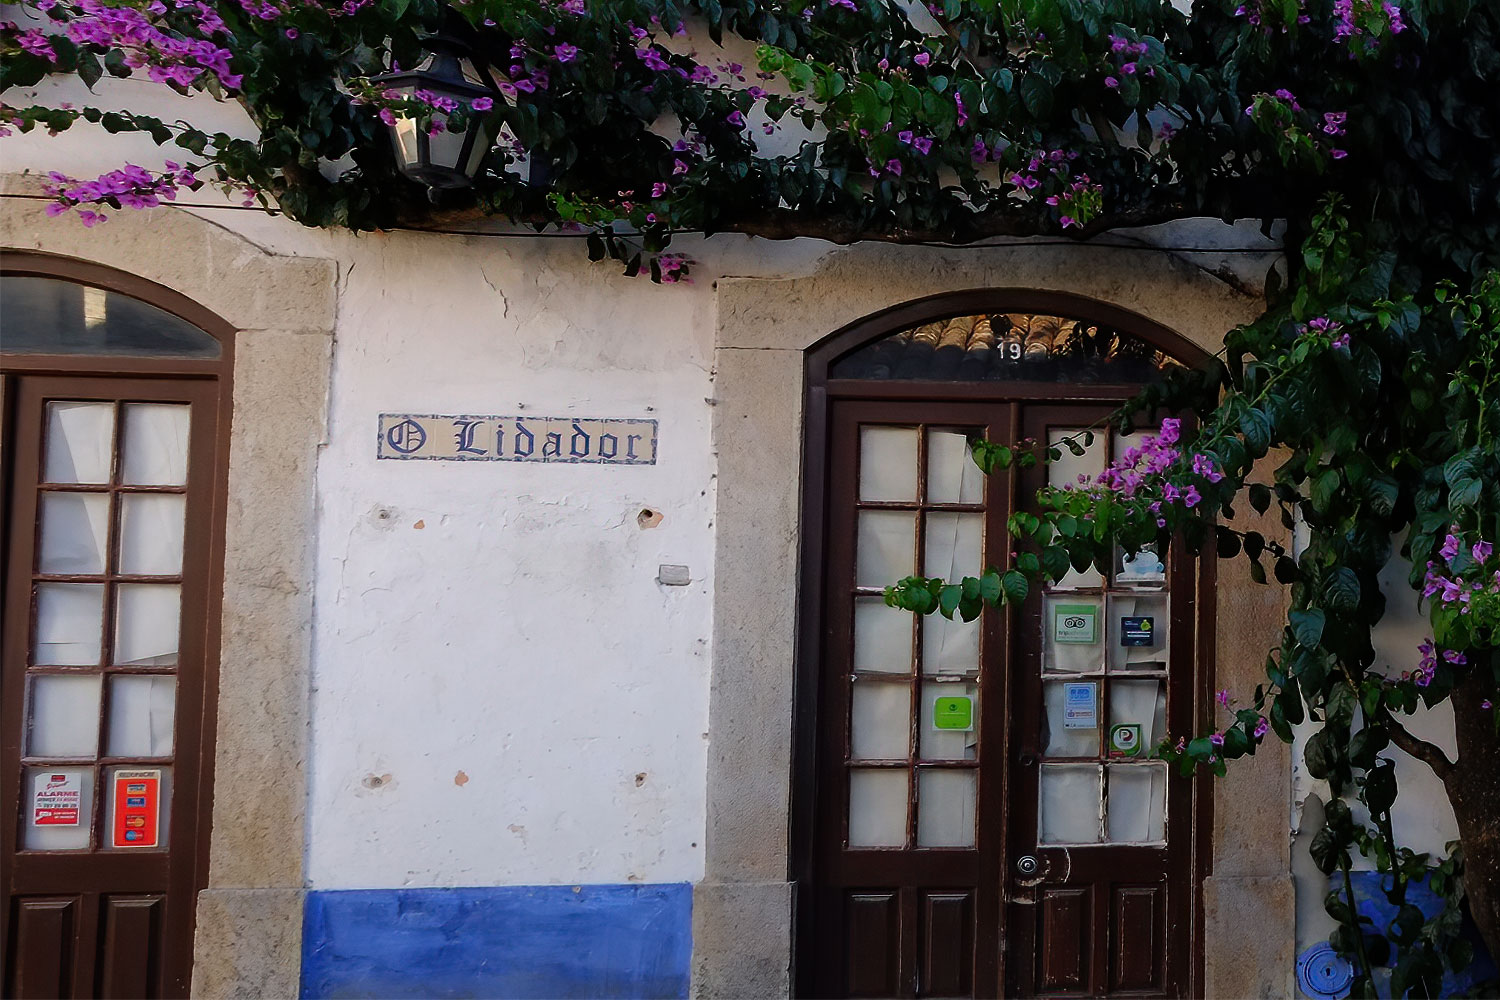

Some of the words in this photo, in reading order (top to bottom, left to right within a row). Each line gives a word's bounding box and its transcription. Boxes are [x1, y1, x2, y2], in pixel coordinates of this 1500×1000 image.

[997, 342, 1021, 360] 19
[387, 419, 427, 454] O
[453, 420, 643, 459] Lidador
